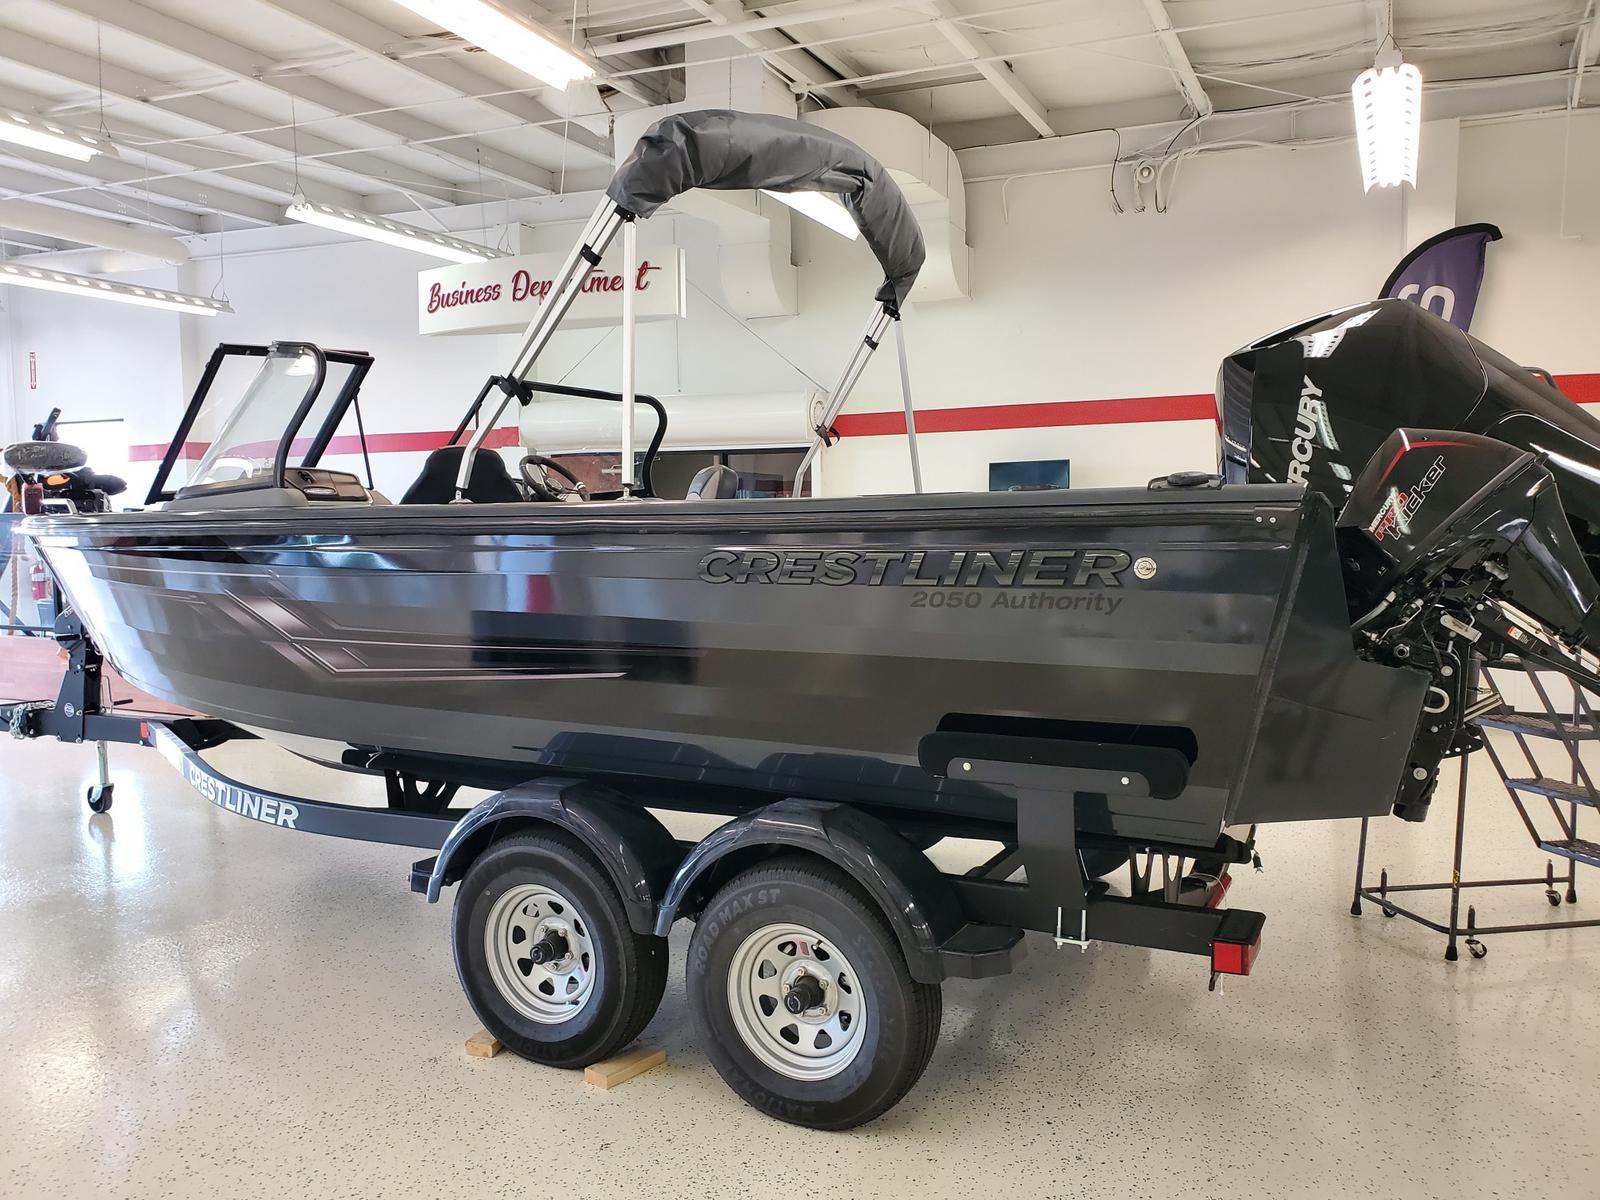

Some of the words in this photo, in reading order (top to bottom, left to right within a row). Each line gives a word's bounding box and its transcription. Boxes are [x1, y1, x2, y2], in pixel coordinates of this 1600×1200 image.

[427, 281, 501, 313] Business
[698, 548, 1133, 587] CRESTLINER
[910, 591, 982, 609] 2050
[991, 591, 1123, 616] Authority
[188, 764, 299, 829] CRESTLINER
[694, 921, 720, 976] ROAD
[718, 892, 753, 926] MAX
[757, 888, 780, 905] ST
